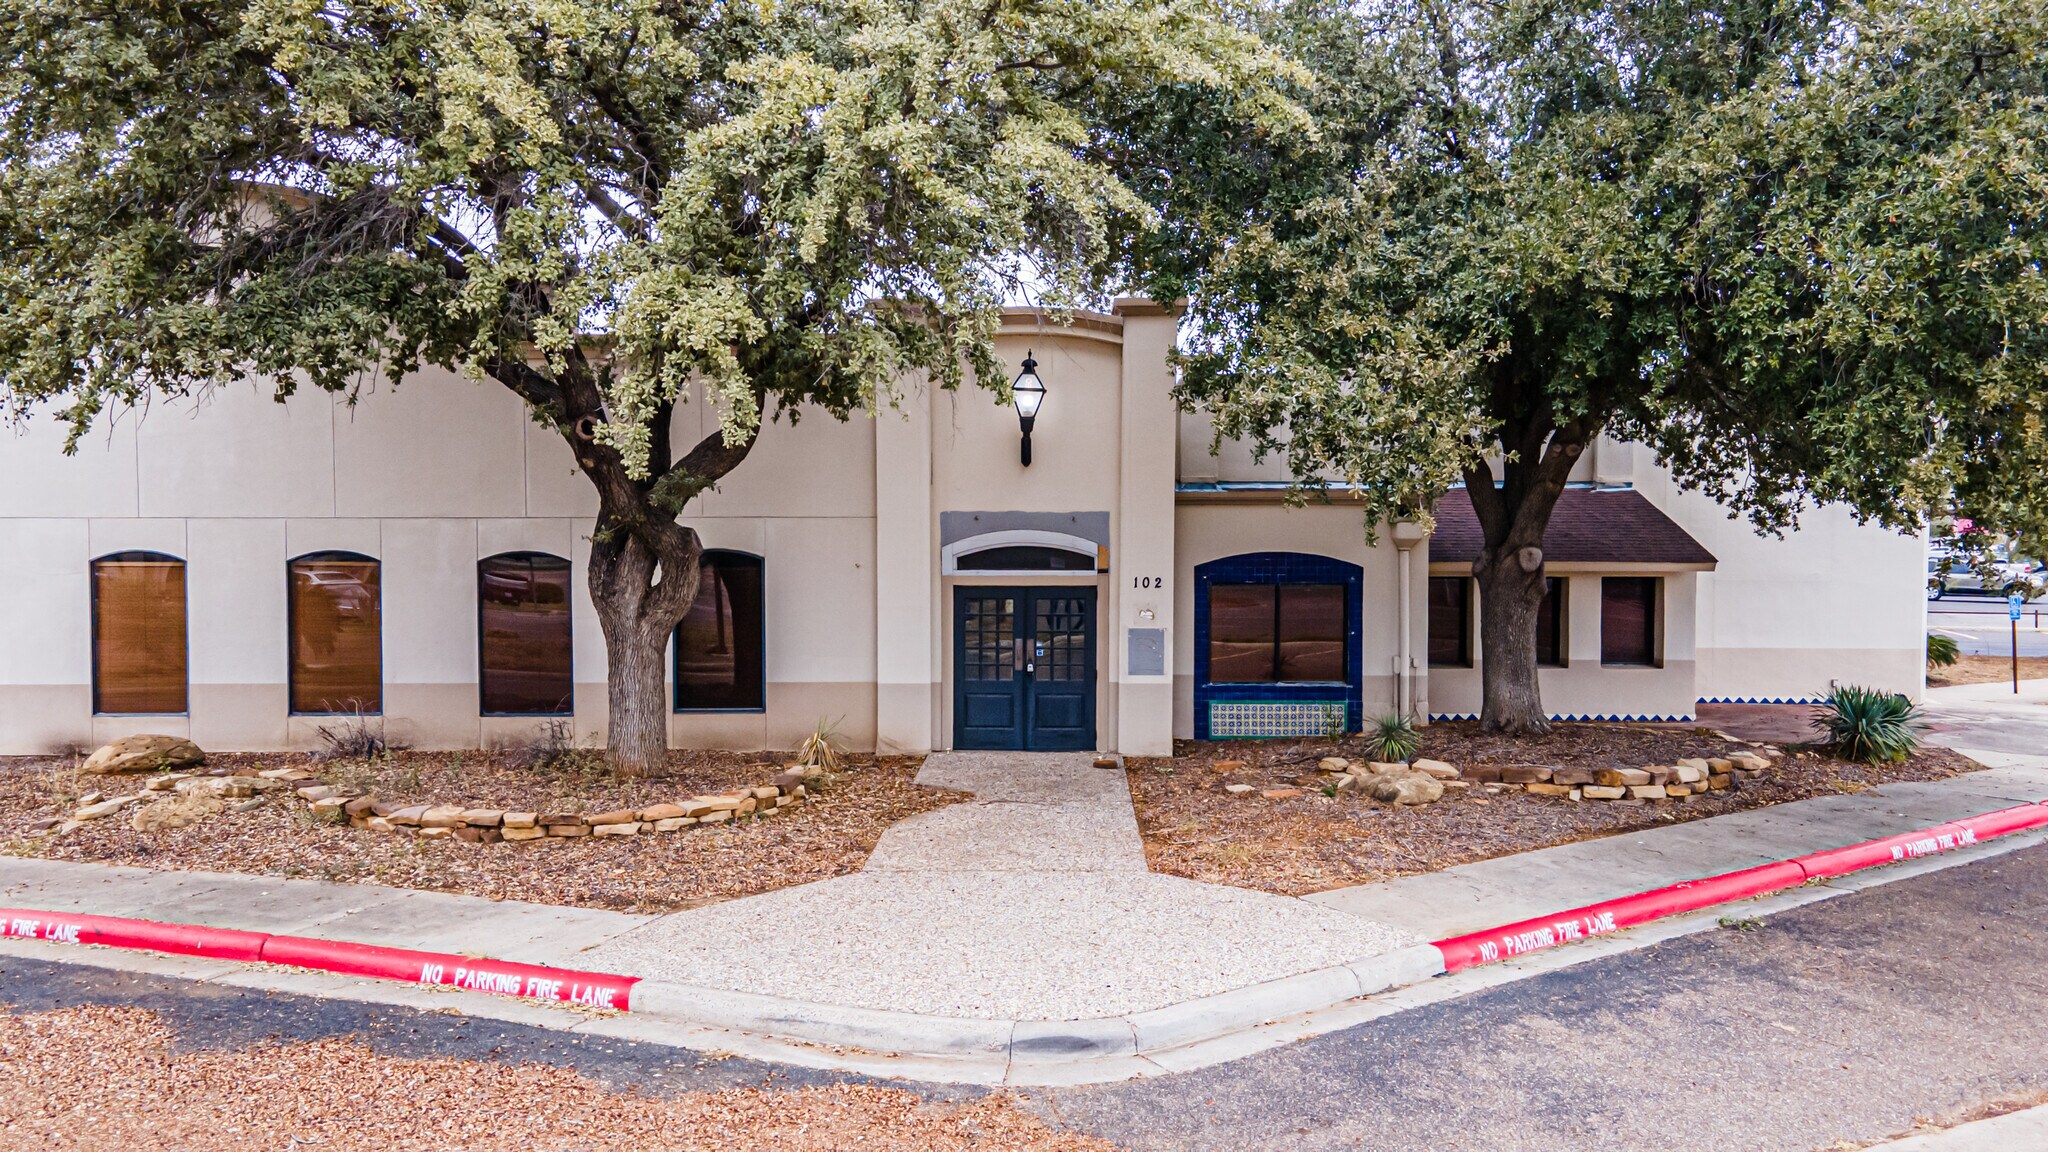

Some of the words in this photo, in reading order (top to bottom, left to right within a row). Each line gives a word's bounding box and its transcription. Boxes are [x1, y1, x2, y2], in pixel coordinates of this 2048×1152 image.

[1134, 576, 1162, 589] 102
[1890, 846, 1903, 860] NO
[1905, 838, 1938, 856] PARKING
[1938, 834, 1955, 849] FIRE
[1956, 829, 1977, 845] LANE
[11, 919, 40, 936] FIRE
[45, 922, 81, 942] LANE
[1479, 941, 1498, 961] NO
[1503, 927, 1555, 955] PARKING
[1554, 920, 1582, 941] FIRE
[1585, 912, 1616, 934] LANE
[421, 963, 443, 983] NO
[454, 968, 521, 994] PARKING
[526, 977, 563, 1000] FIRE
[570, 983, 616, 1007] LANE
